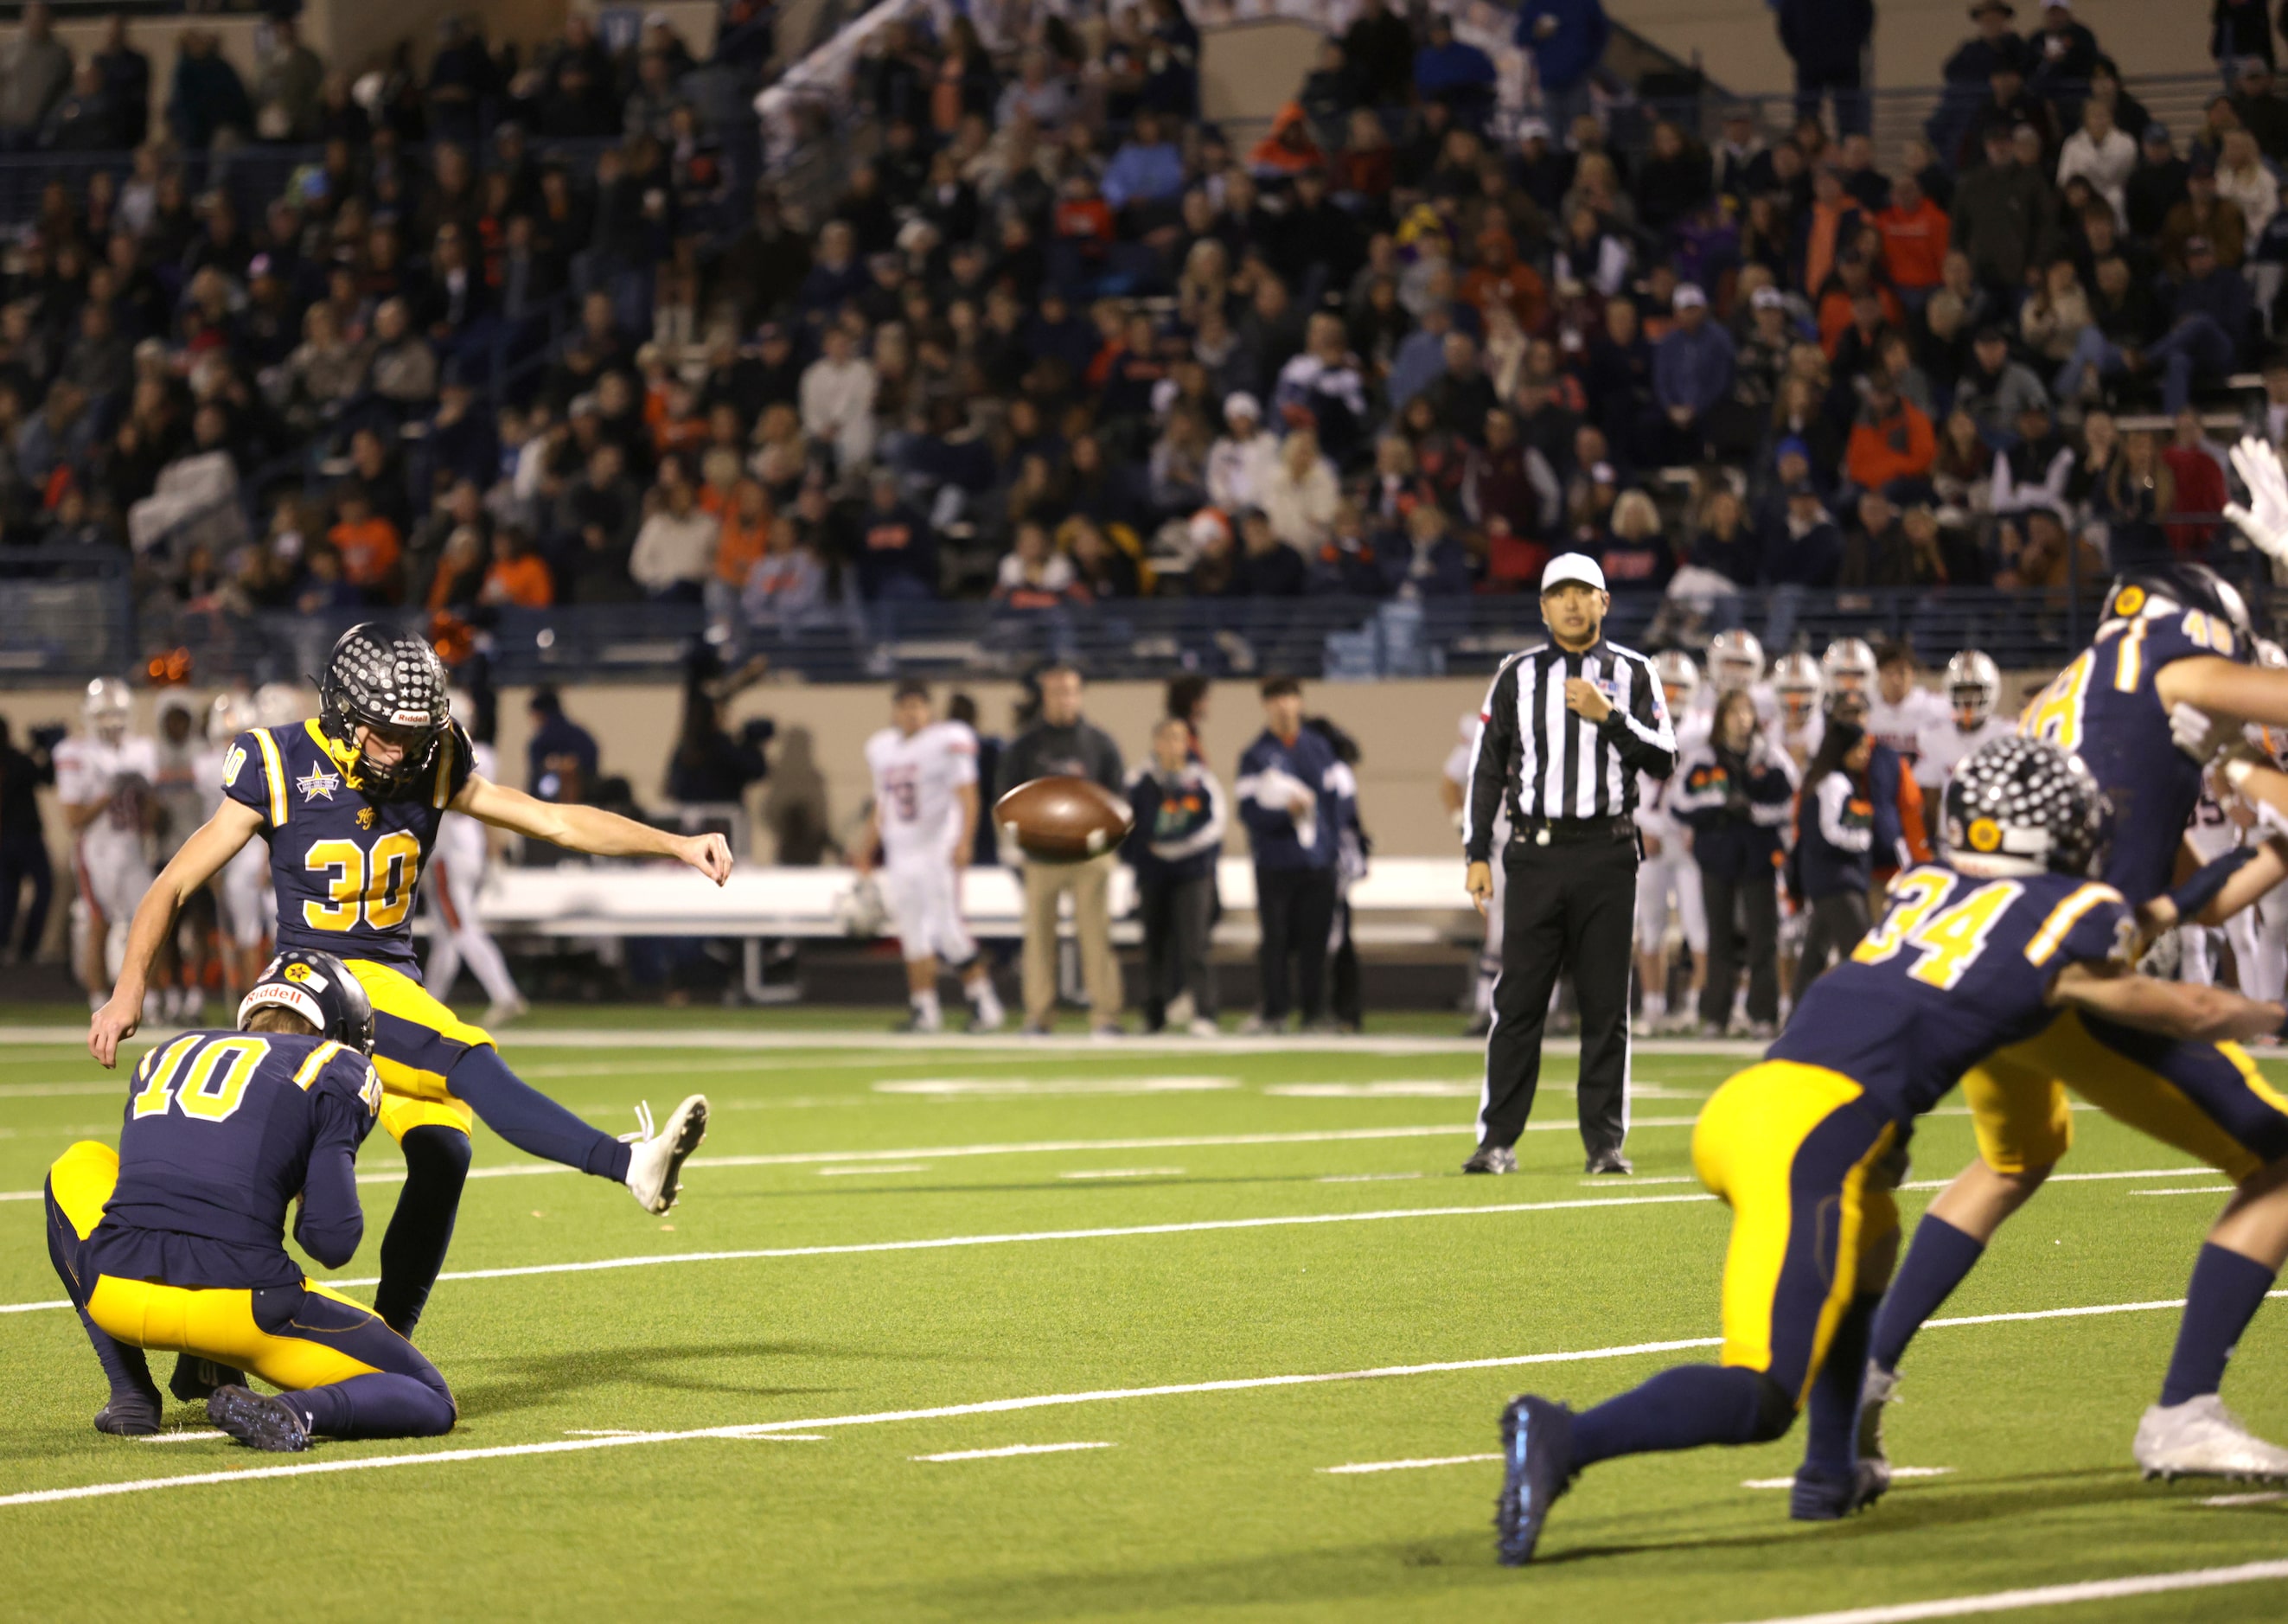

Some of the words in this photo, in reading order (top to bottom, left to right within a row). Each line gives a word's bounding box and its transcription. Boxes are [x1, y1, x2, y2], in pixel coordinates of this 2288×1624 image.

[303, 828, 421, 932] 30
[1850, 865, 2027, 991] 34
[246, 987, 302, 1006] Riddell
[133, 1034, 272, 1122] 10
